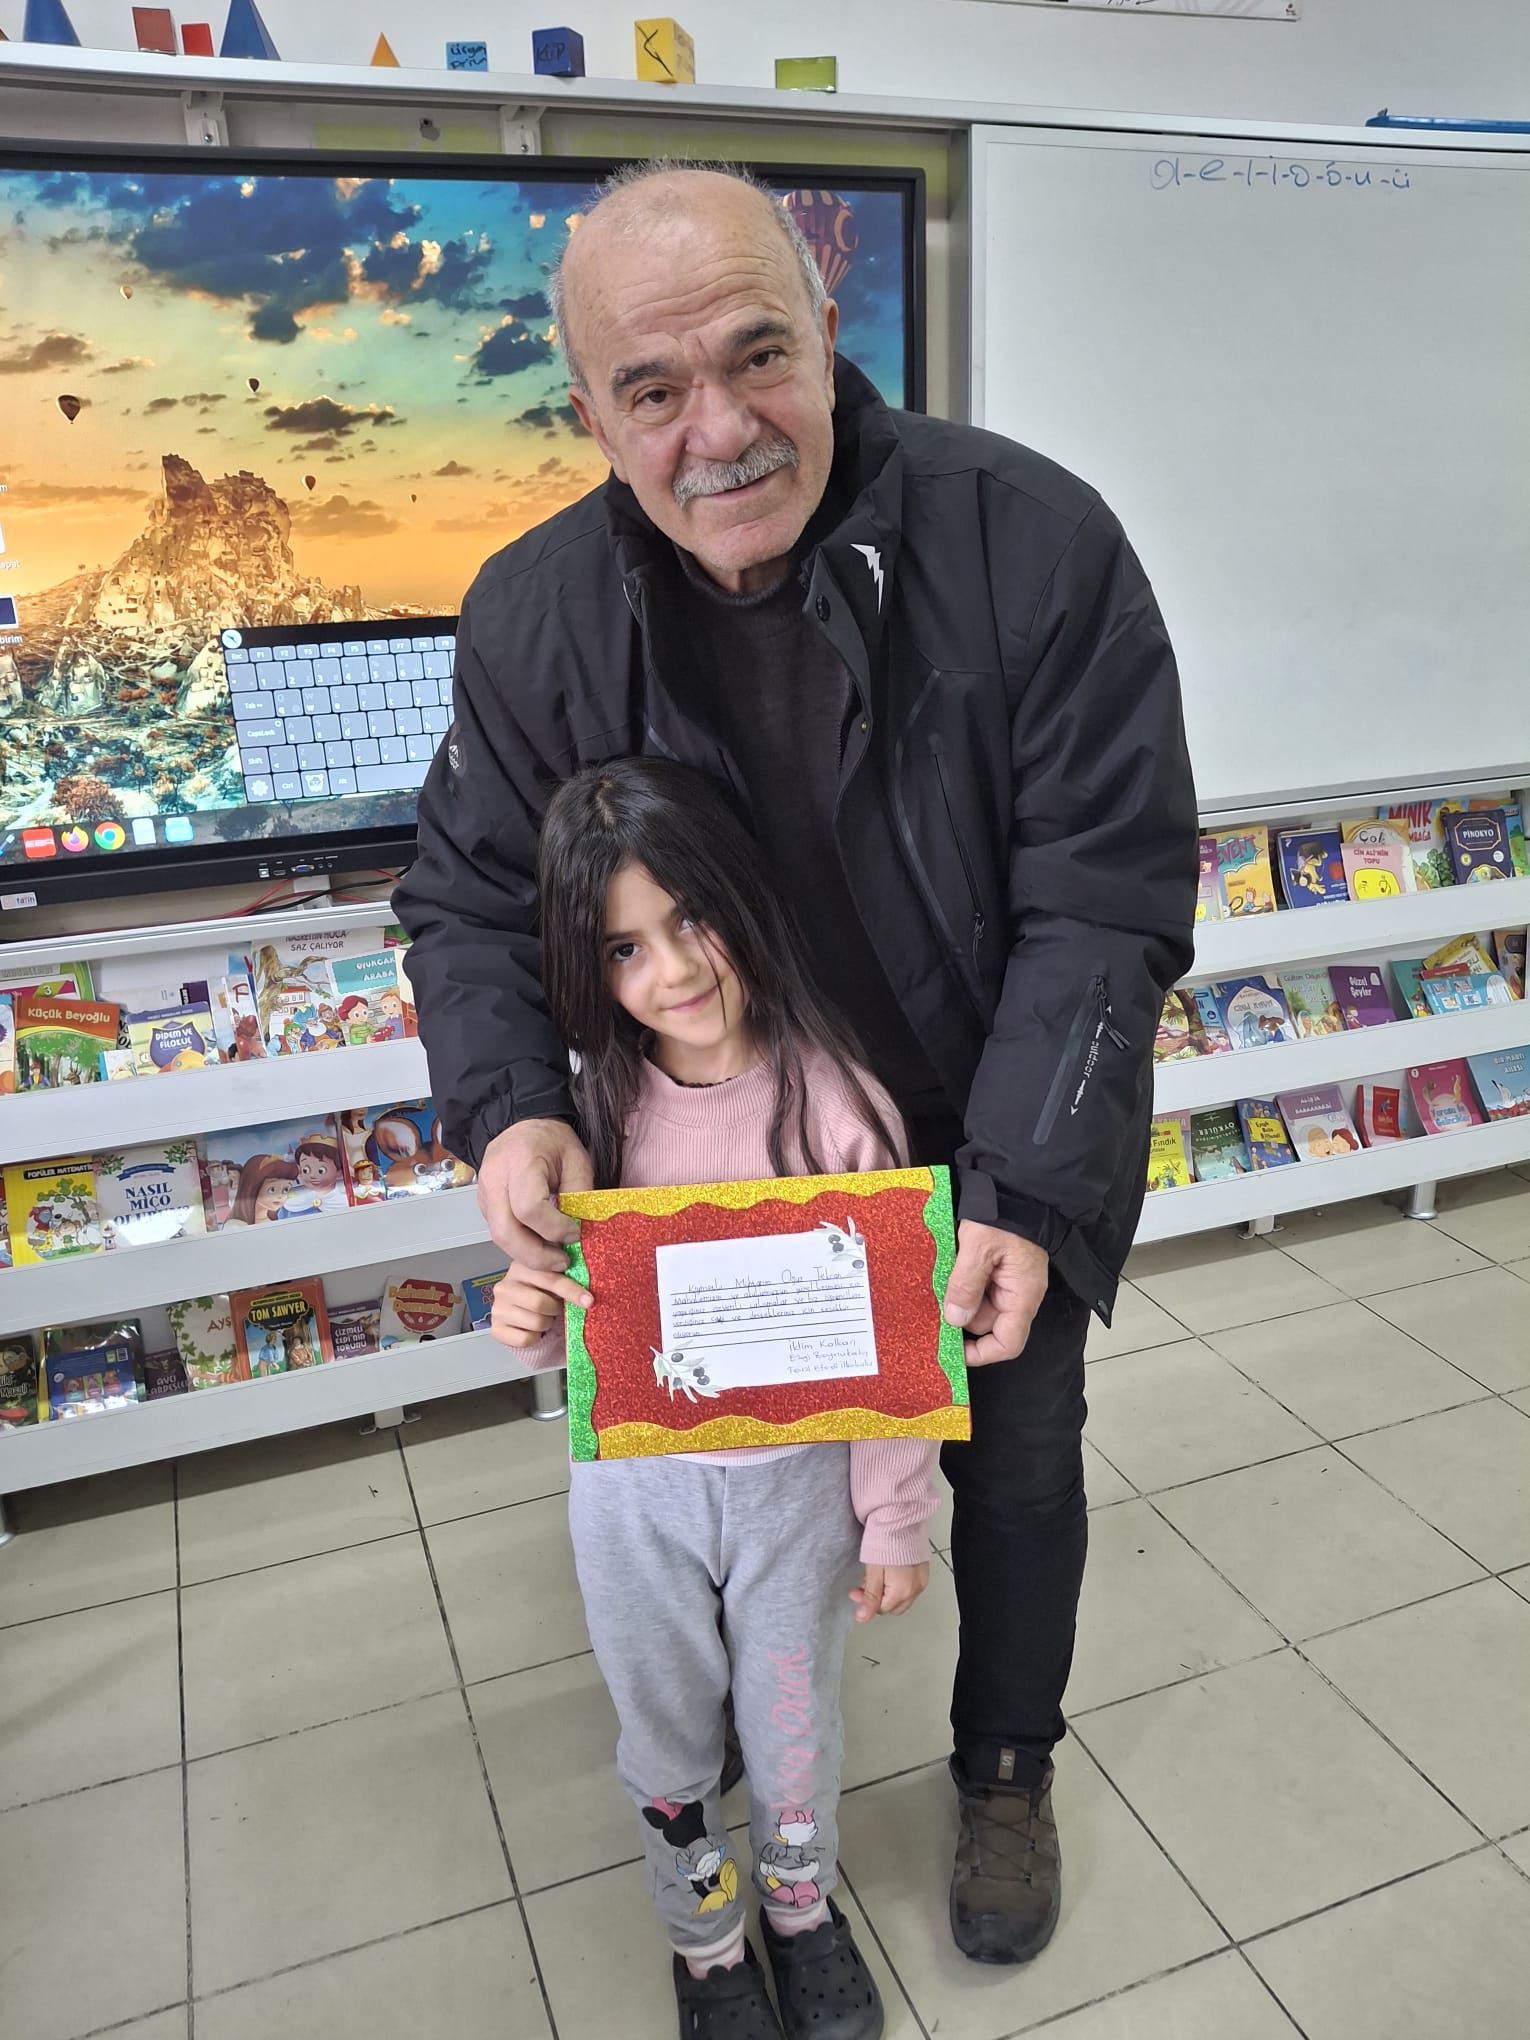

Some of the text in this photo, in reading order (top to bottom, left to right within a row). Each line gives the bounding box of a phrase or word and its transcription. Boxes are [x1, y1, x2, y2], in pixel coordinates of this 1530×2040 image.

[1462, 828, 1495, 839] PİNOKYO
[290, 940, 344, 952] SAZ ÇALIYOR
[1348, 976, 1368, 986] Güzel
[44, 985, 52, 995] 3
[1350, 986, 1372, 998] Şeyler
[27, 1007, 111, 1024] Küçük Beyoğlu
[27, 1167, 56, 1180] POPÜLER
[125, 1182, 172, 1199] NASIL
[130, 1194, 172, 1212] MİÇO
[250, 1301, 307, 1321] TOM SAWYER
